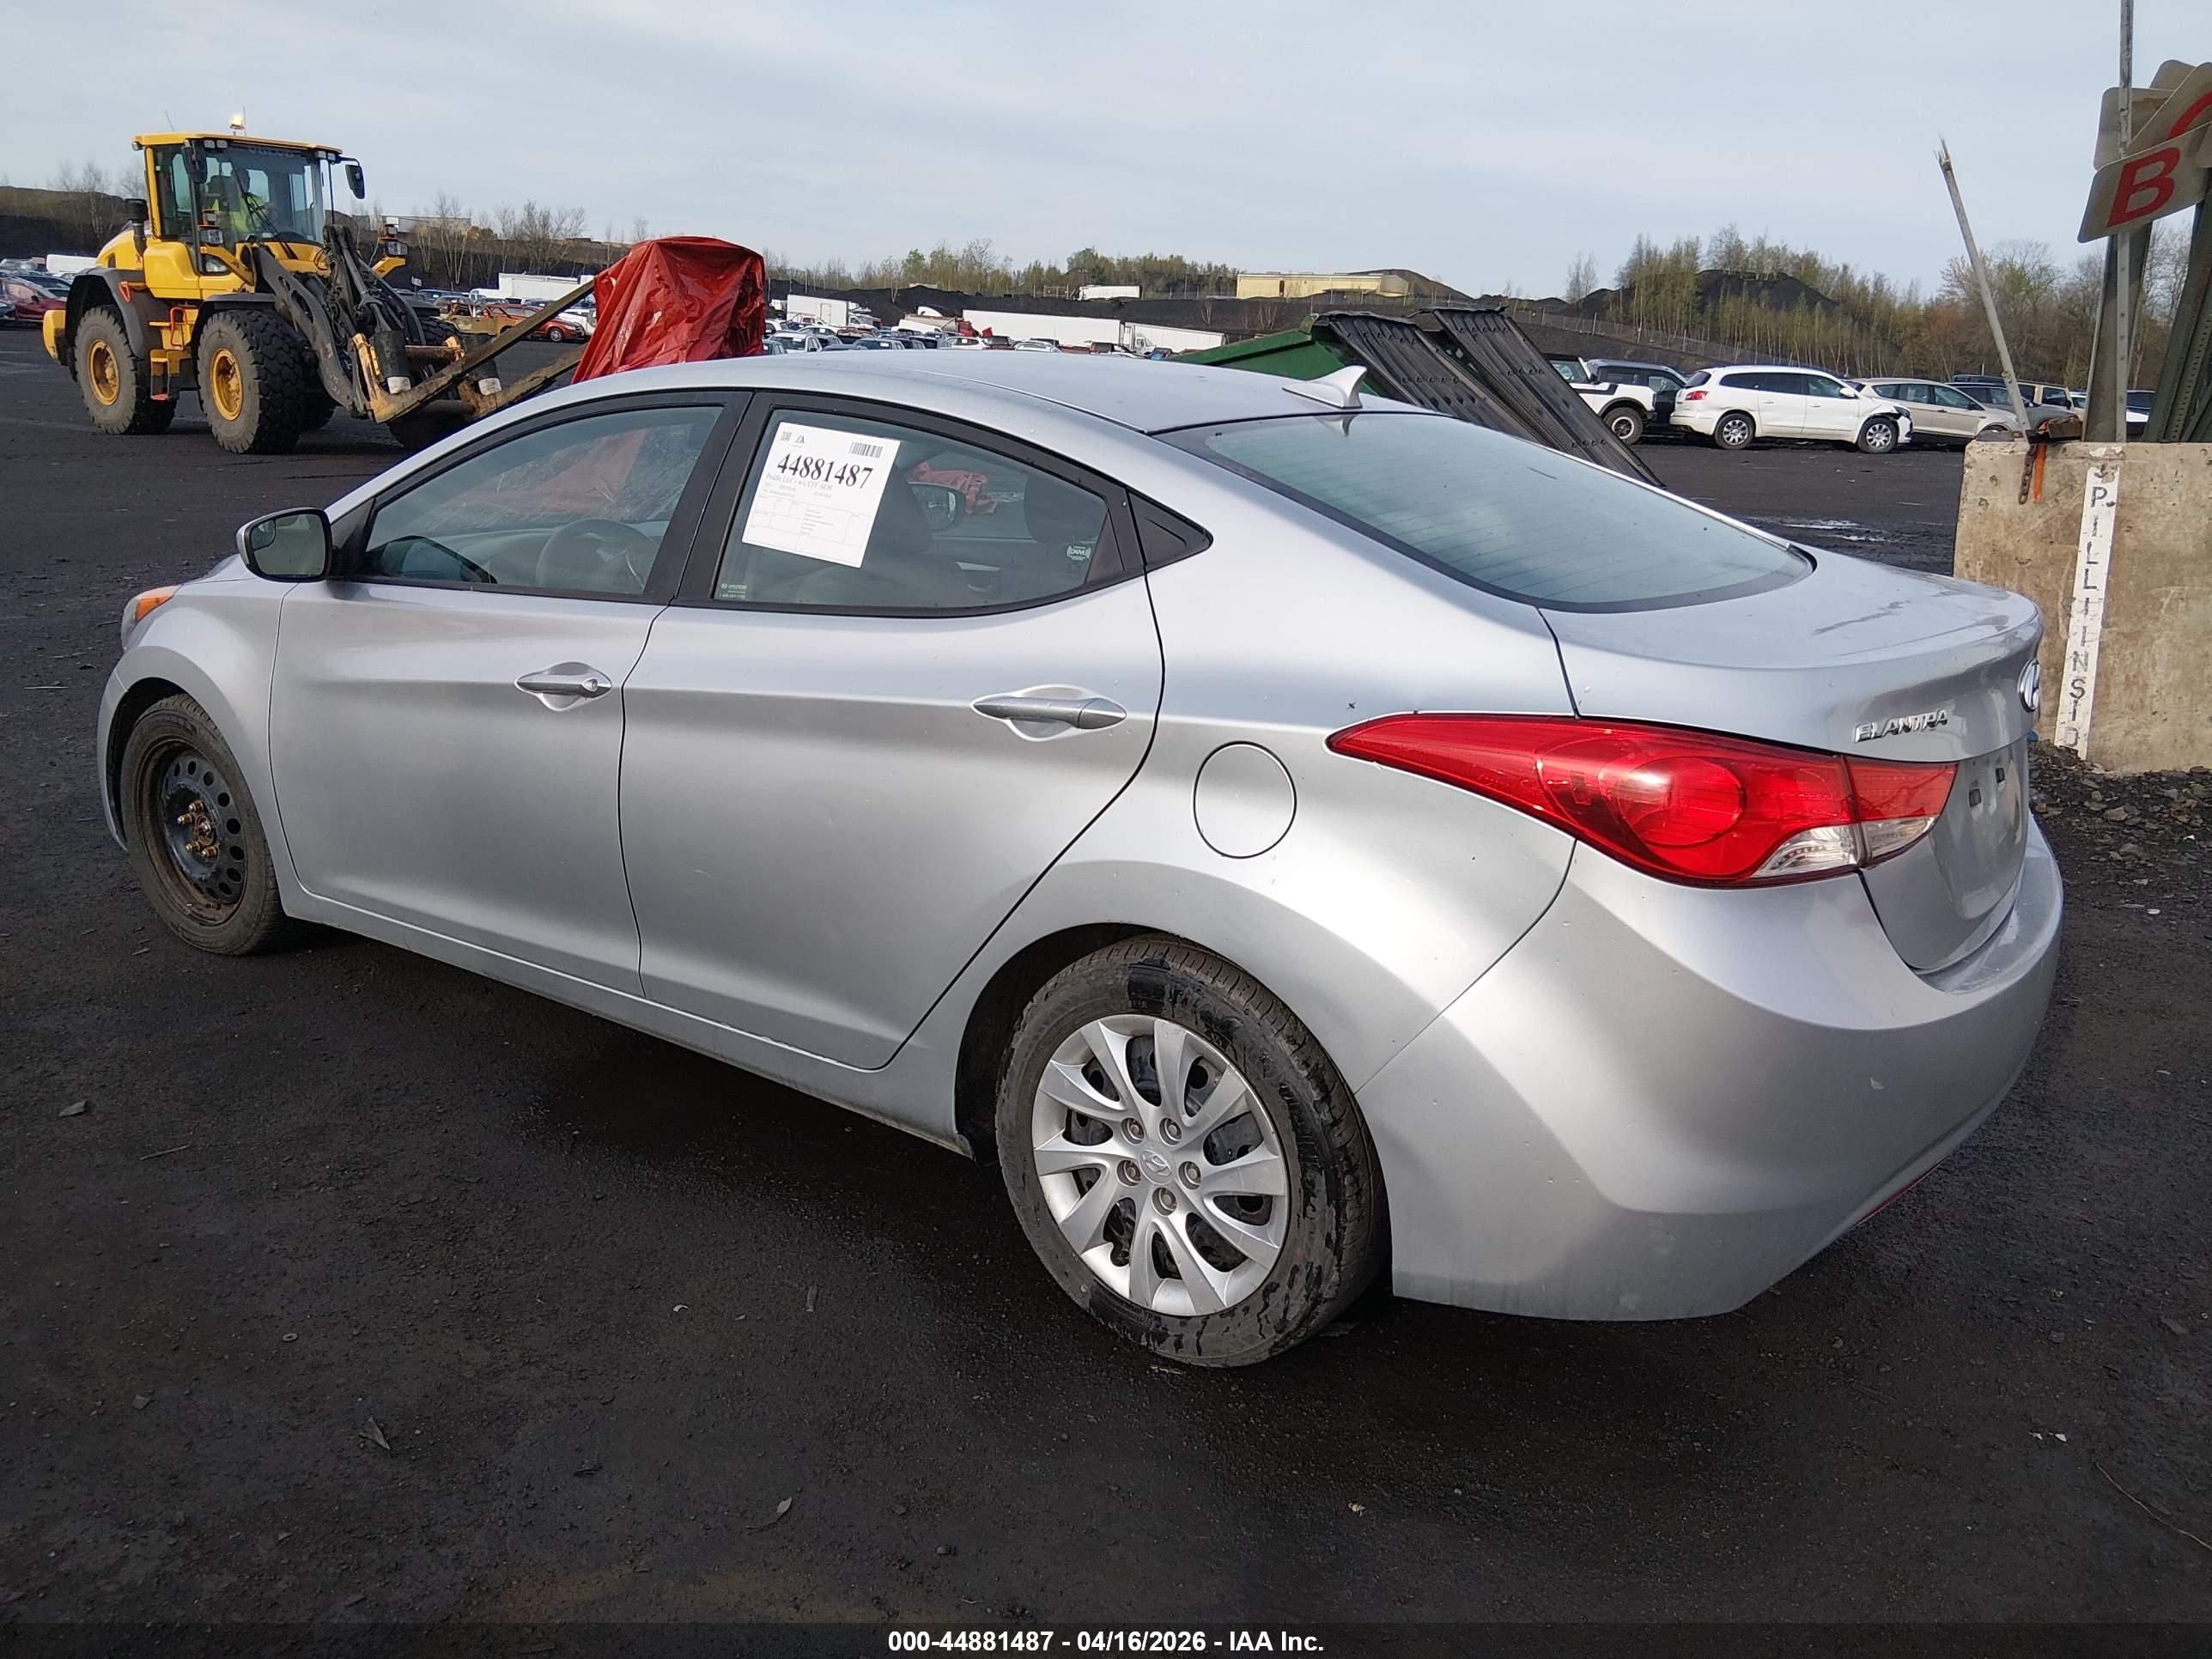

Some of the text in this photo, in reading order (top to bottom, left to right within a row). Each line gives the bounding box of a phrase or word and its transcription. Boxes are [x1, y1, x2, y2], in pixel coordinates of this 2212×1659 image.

[2106, 147, 2181, 228] B
[776, 453, 874, 489] 44881487
[1853, 708, 1949, 744] ELANTRA
